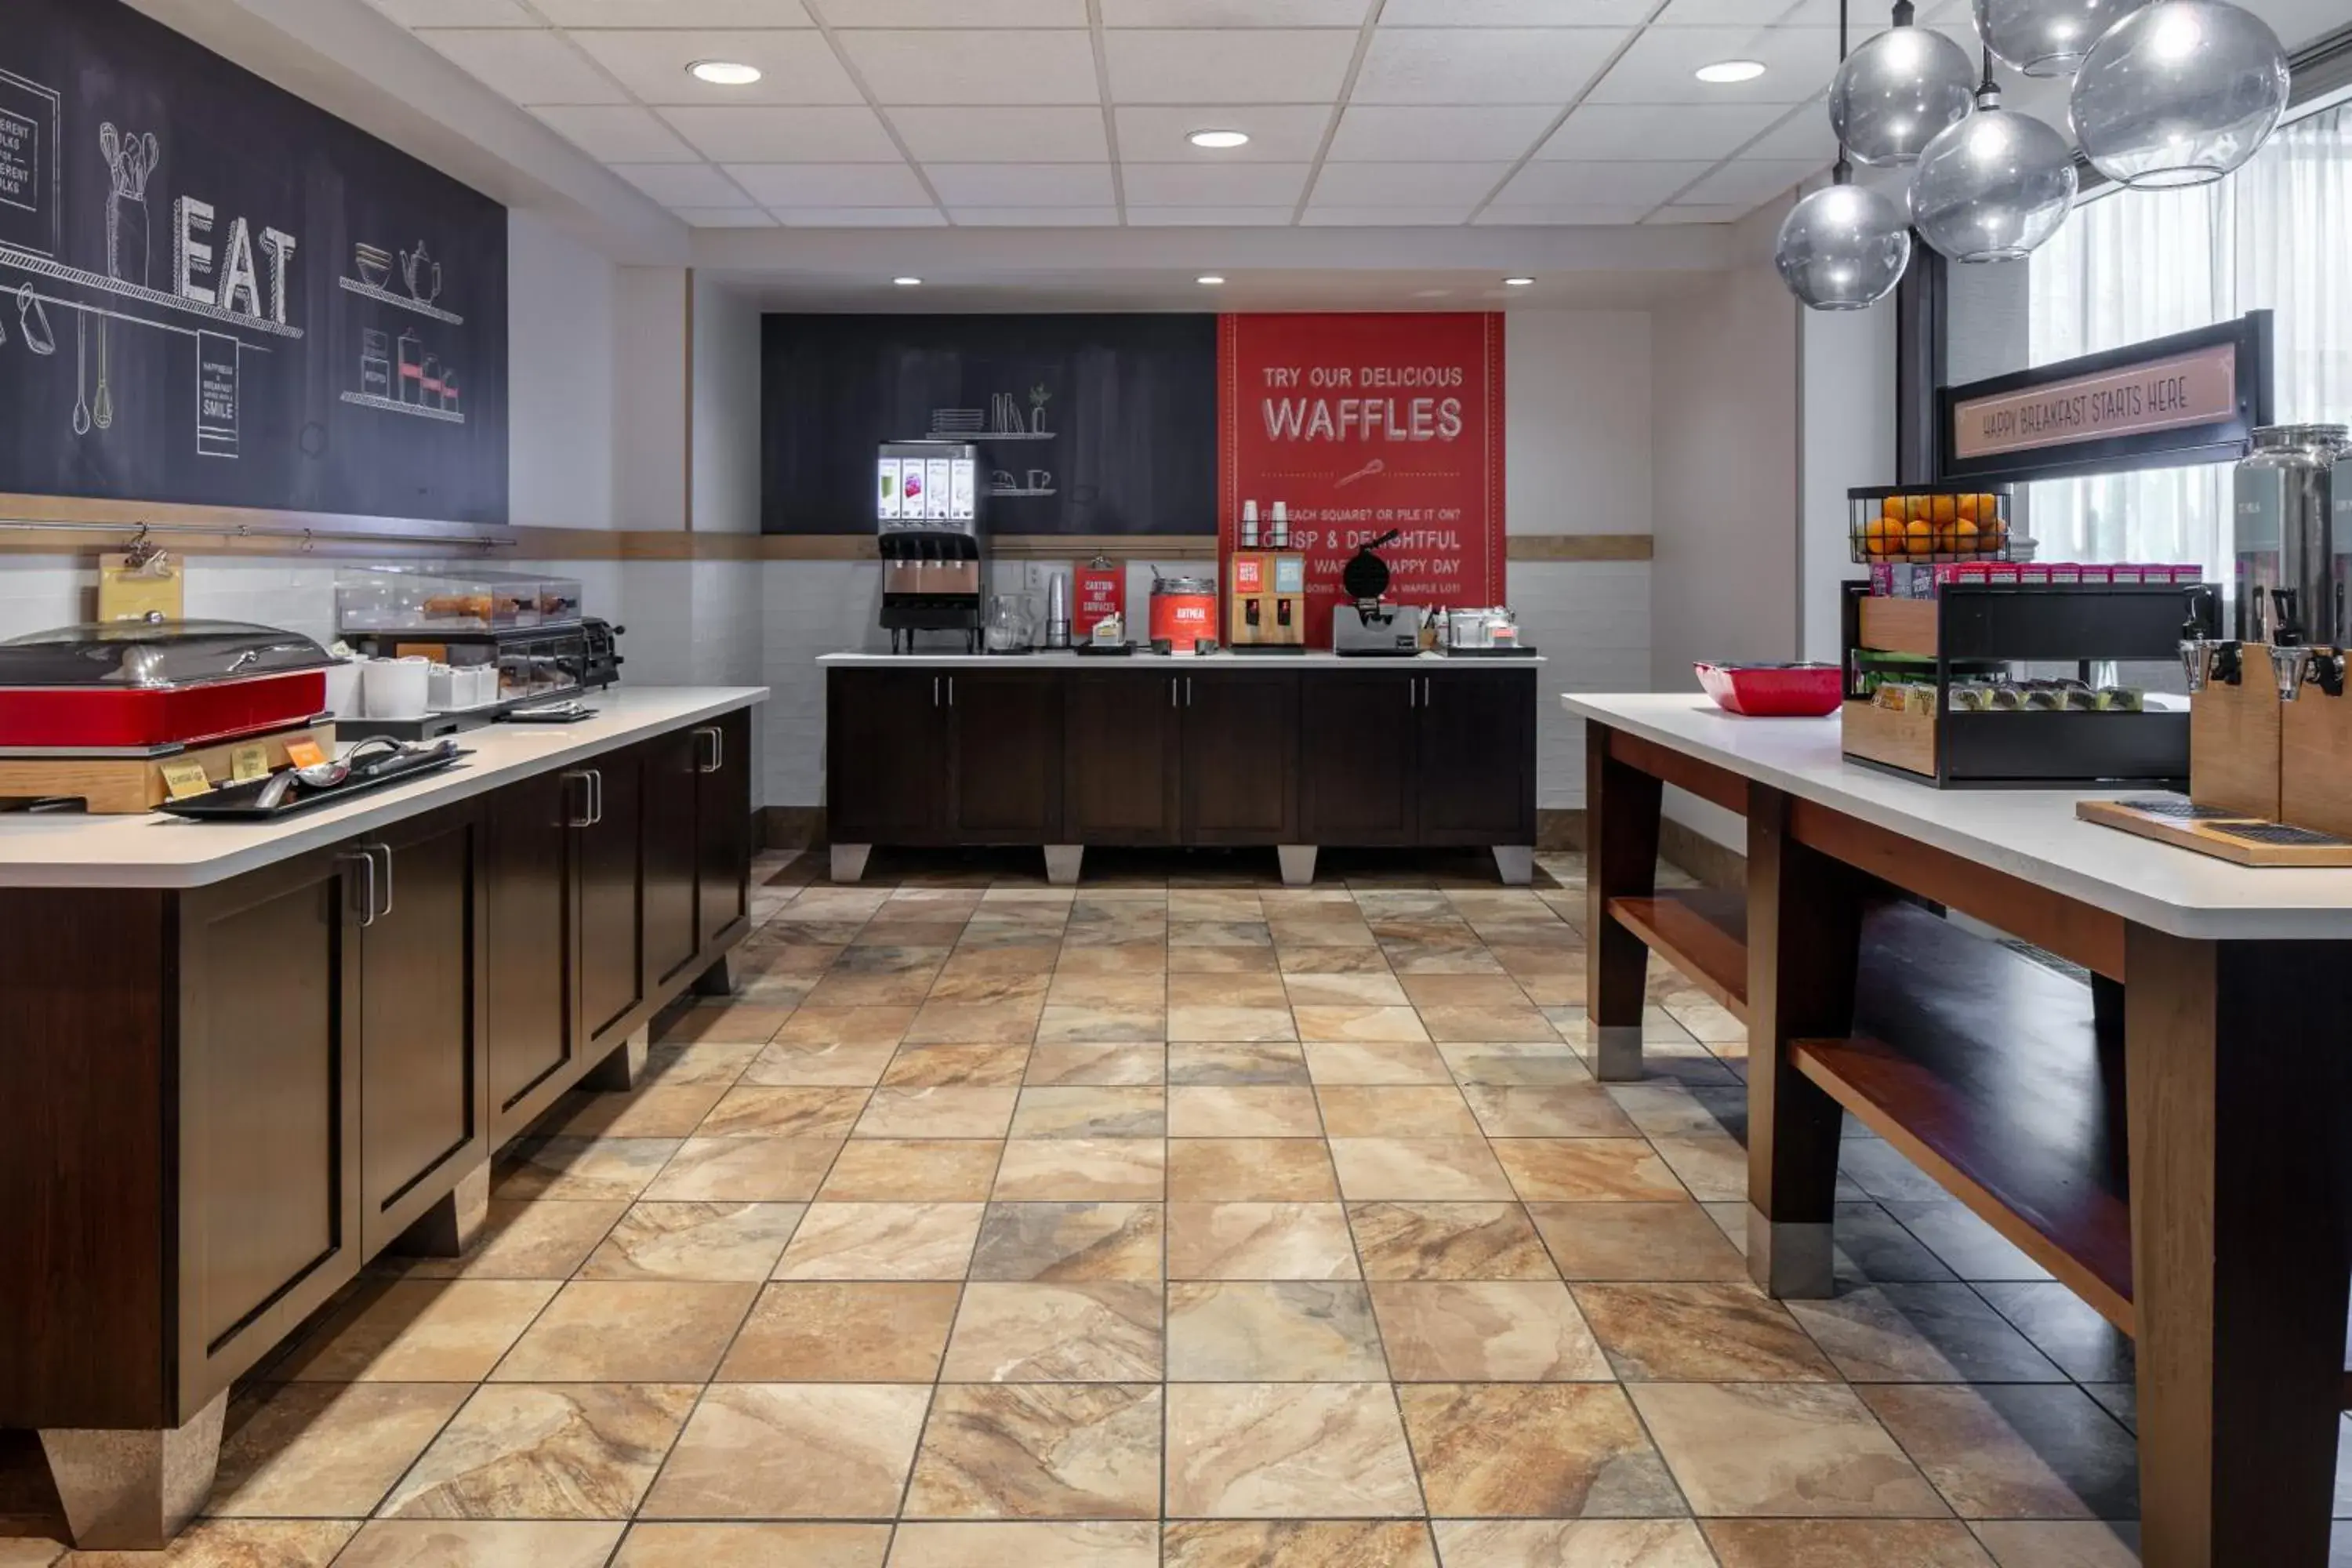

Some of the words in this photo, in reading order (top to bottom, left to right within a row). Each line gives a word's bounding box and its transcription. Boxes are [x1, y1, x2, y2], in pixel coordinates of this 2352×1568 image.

[174, 195, 296, 324] EAT
[1262, 367, 1301, 387] TRY
[1309, 367, 1352, 388] OUR
[1360, 366, 1463, 387] DELICIOUS
[203, 398, 233, 419] SMILE
[1982, 410, 2017, 438] HAPPY
[2020, 395, 2088, 434] BREAKFAST
[2092, 385, 2142, 423] STARTS
[2147, 376, 2189, 411] HERE
[1262, 397, 1463, 442] WAFFLES
[1289, 510, 1317, 521] EACH
[1320, 510, 1372, 521] SQUARE?
[1376, 510, 1392, 521] OR
[1397, 510, 1420, 521] PILE
[1424, 510, 1435, 520] IT
[1438, 510, 1461, 521] ON?
[1262, 531, 1319, 548] CISP
[1327, 530, 1339, 548] &
[1432, 559, 1461, 575] DAY
